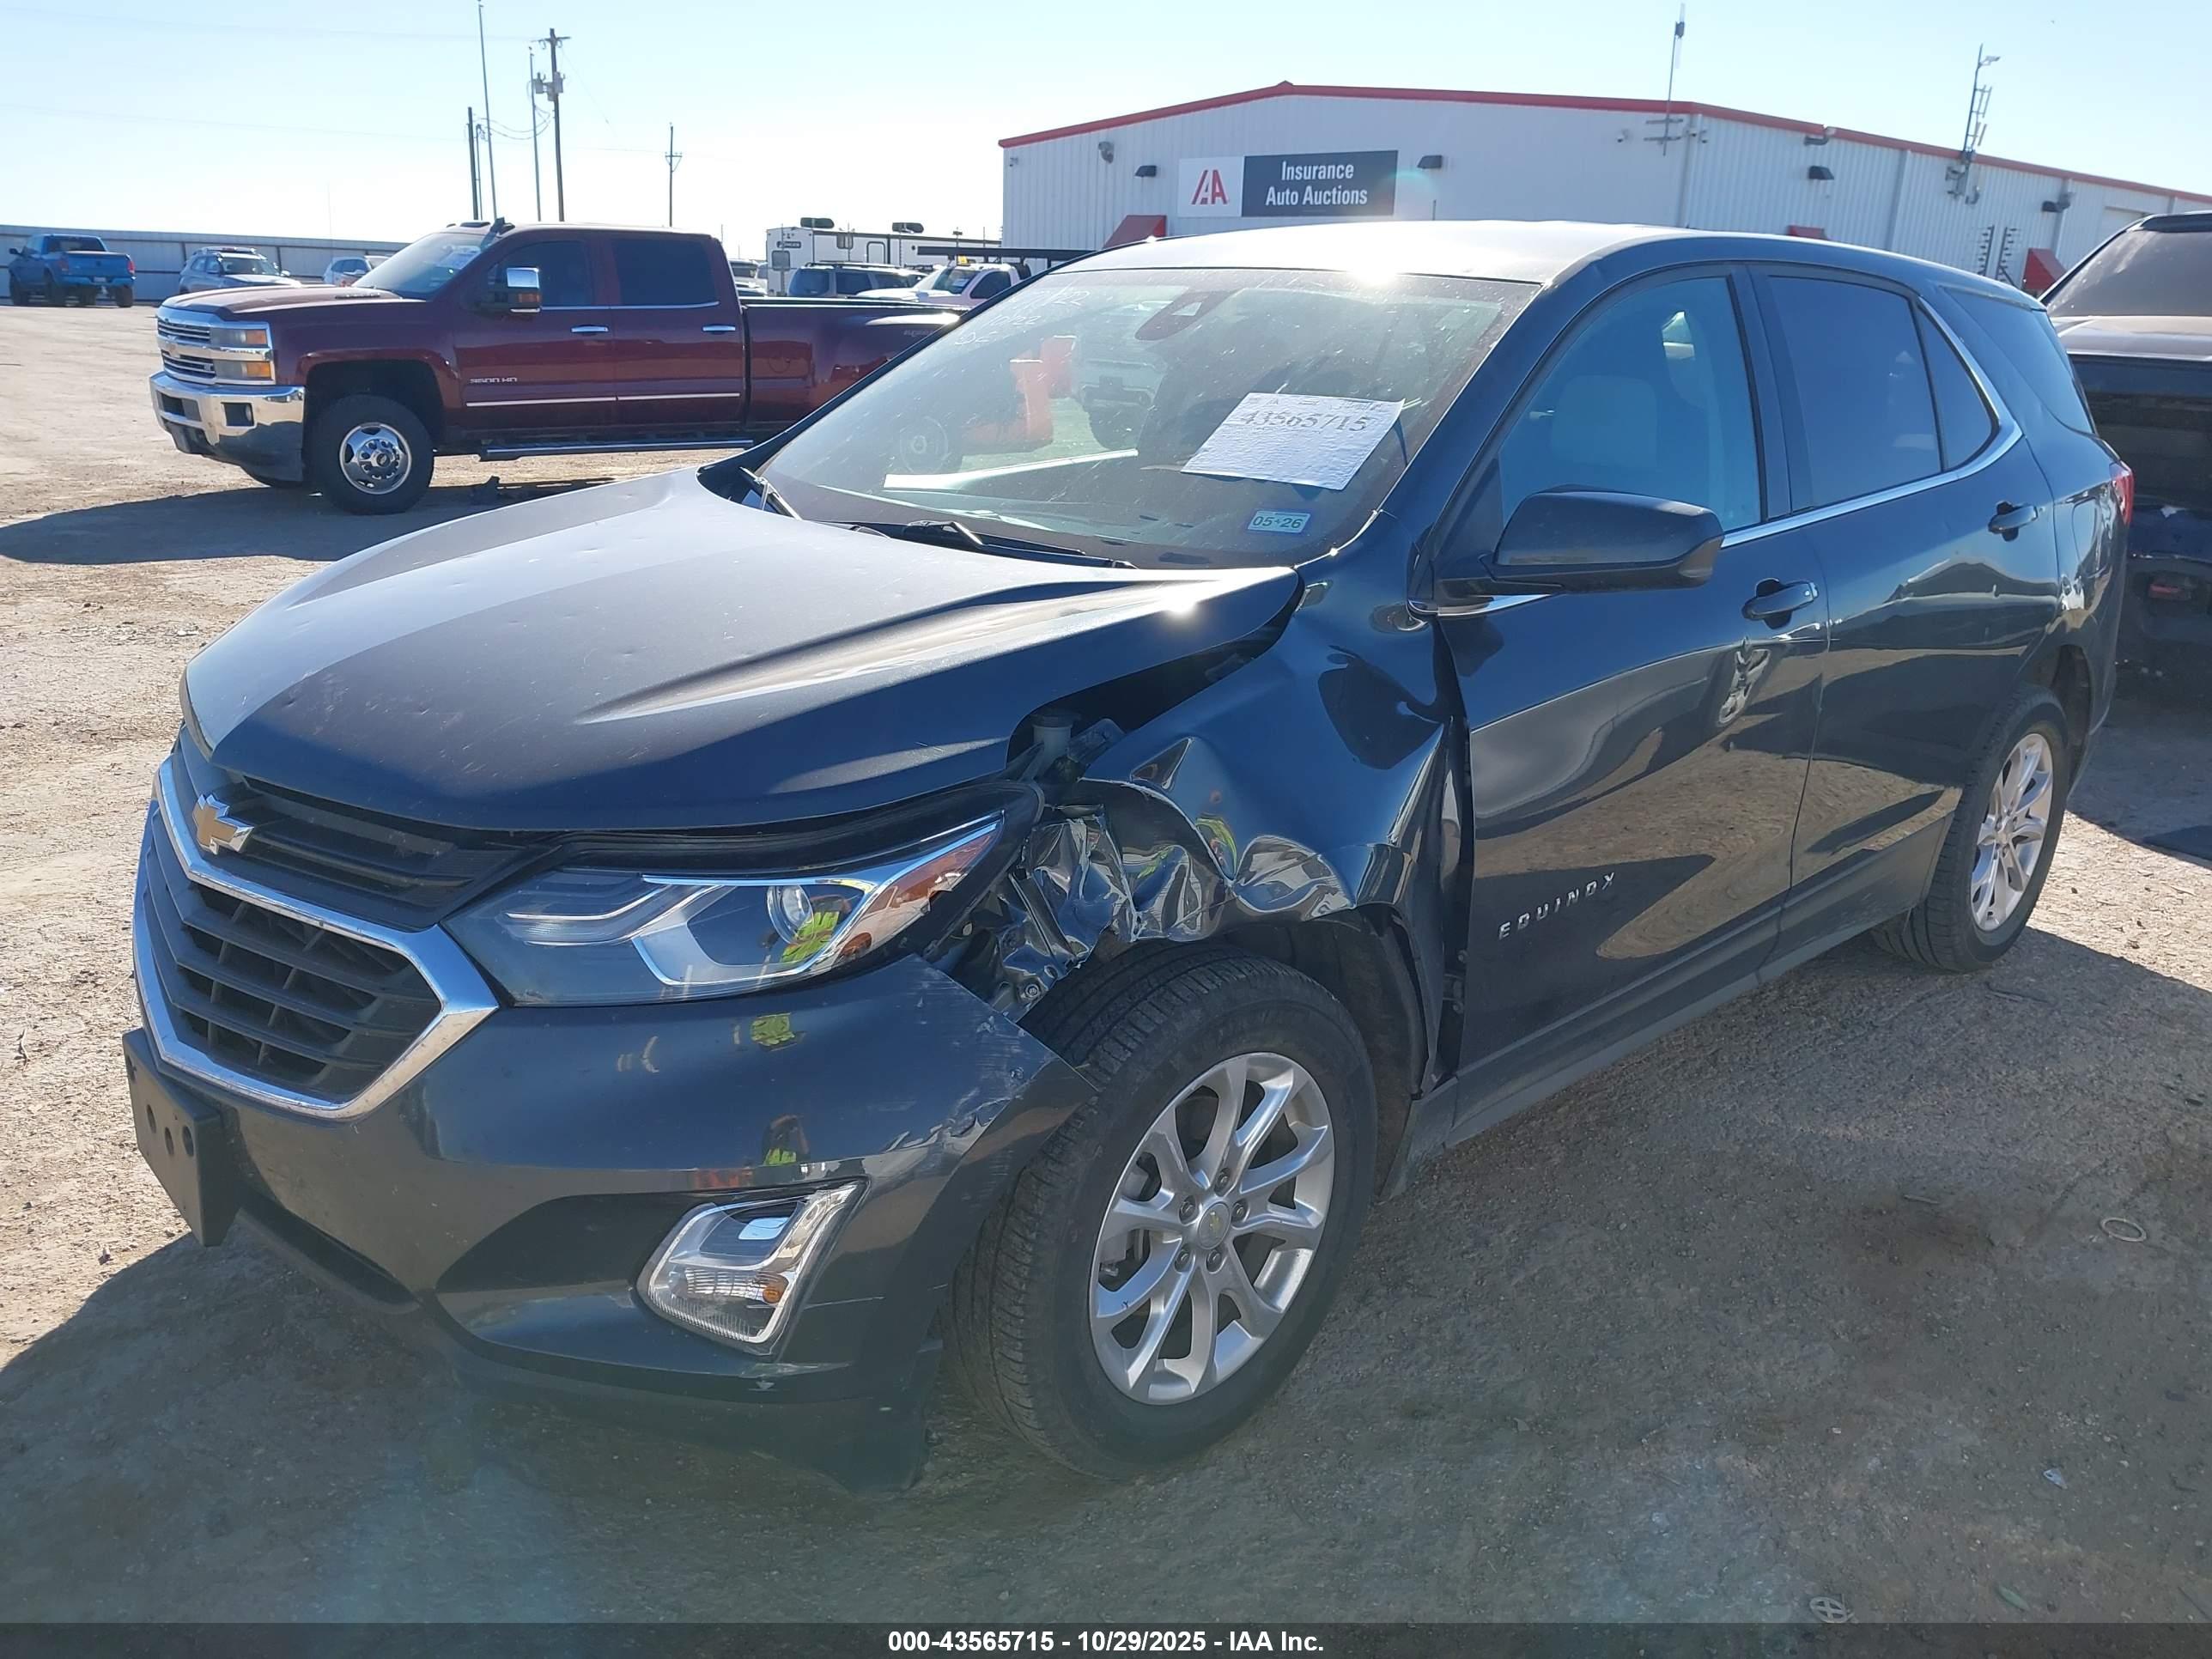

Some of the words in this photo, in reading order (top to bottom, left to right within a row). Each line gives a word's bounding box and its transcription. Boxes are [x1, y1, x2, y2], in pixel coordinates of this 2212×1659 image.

[1281, 161, 1354, 180] Insurance
[1265, 186, 1298, 206] Auto
[1302, 185, 1368, 206] Auctions
[1241, 410, 1374, 432] 43565715
[1498, 872, 1615, 940] EQUINOX
